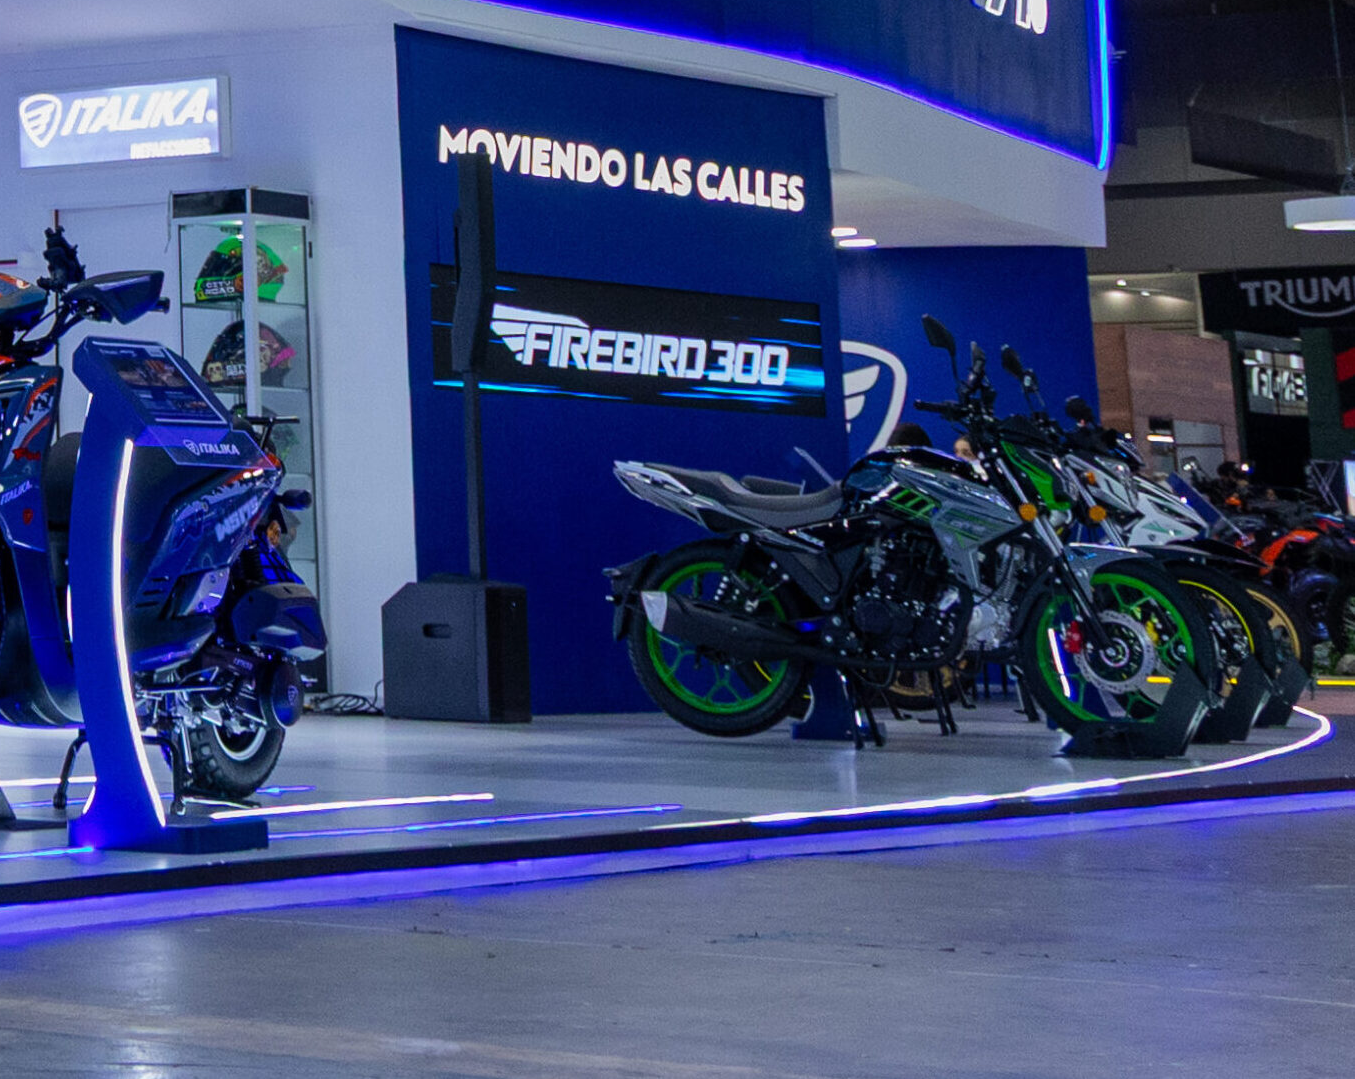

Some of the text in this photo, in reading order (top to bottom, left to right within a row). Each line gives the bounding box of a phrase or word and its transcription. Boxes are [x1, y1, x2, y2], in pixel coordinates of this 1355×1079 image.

[438, 123, 806, 214] MOVIENDO LAS CALLES
[522, 323, 790, 386] FIREBIRD 300
[198, 442, 241, 456] ITALIKA
